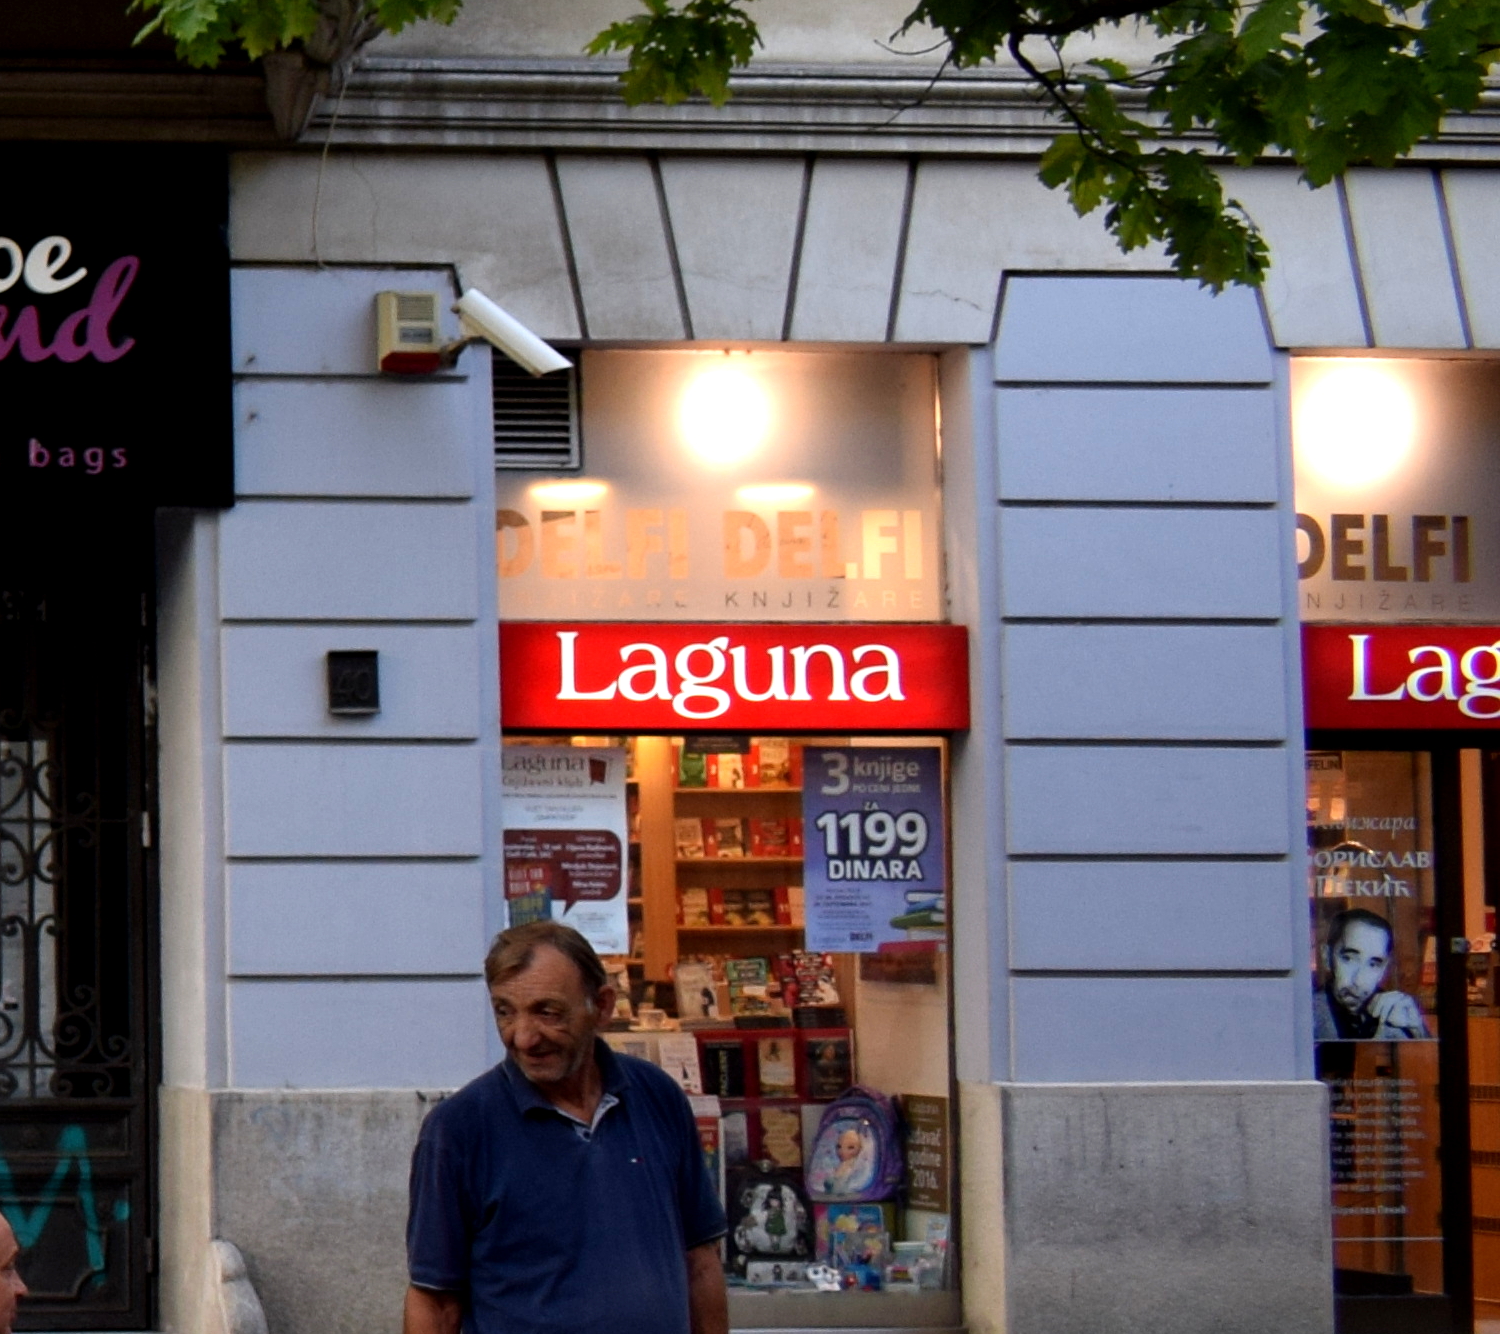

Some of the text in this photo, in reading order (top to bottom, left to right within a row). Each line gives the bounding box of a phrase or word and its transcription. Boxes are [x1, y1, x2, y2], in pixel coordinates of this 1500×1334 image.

[28, 438, 128, 475] bags
[723, 509, 922, 580] DELFI
[725, 585, 923, 610] KNJIŽARE
[1307, 590, 1472, 611] NJIŽARE
[555, 630, 906, 720] Laguna
[821, 751, 920, 796] 3 knjige
[864, 801, 879, 811] ZA
[816, 811, 928, 857] 1199
[828, 859, 923, 880] DINARA
[1314, 851, 1432, 868] ОРИСЛАВ
